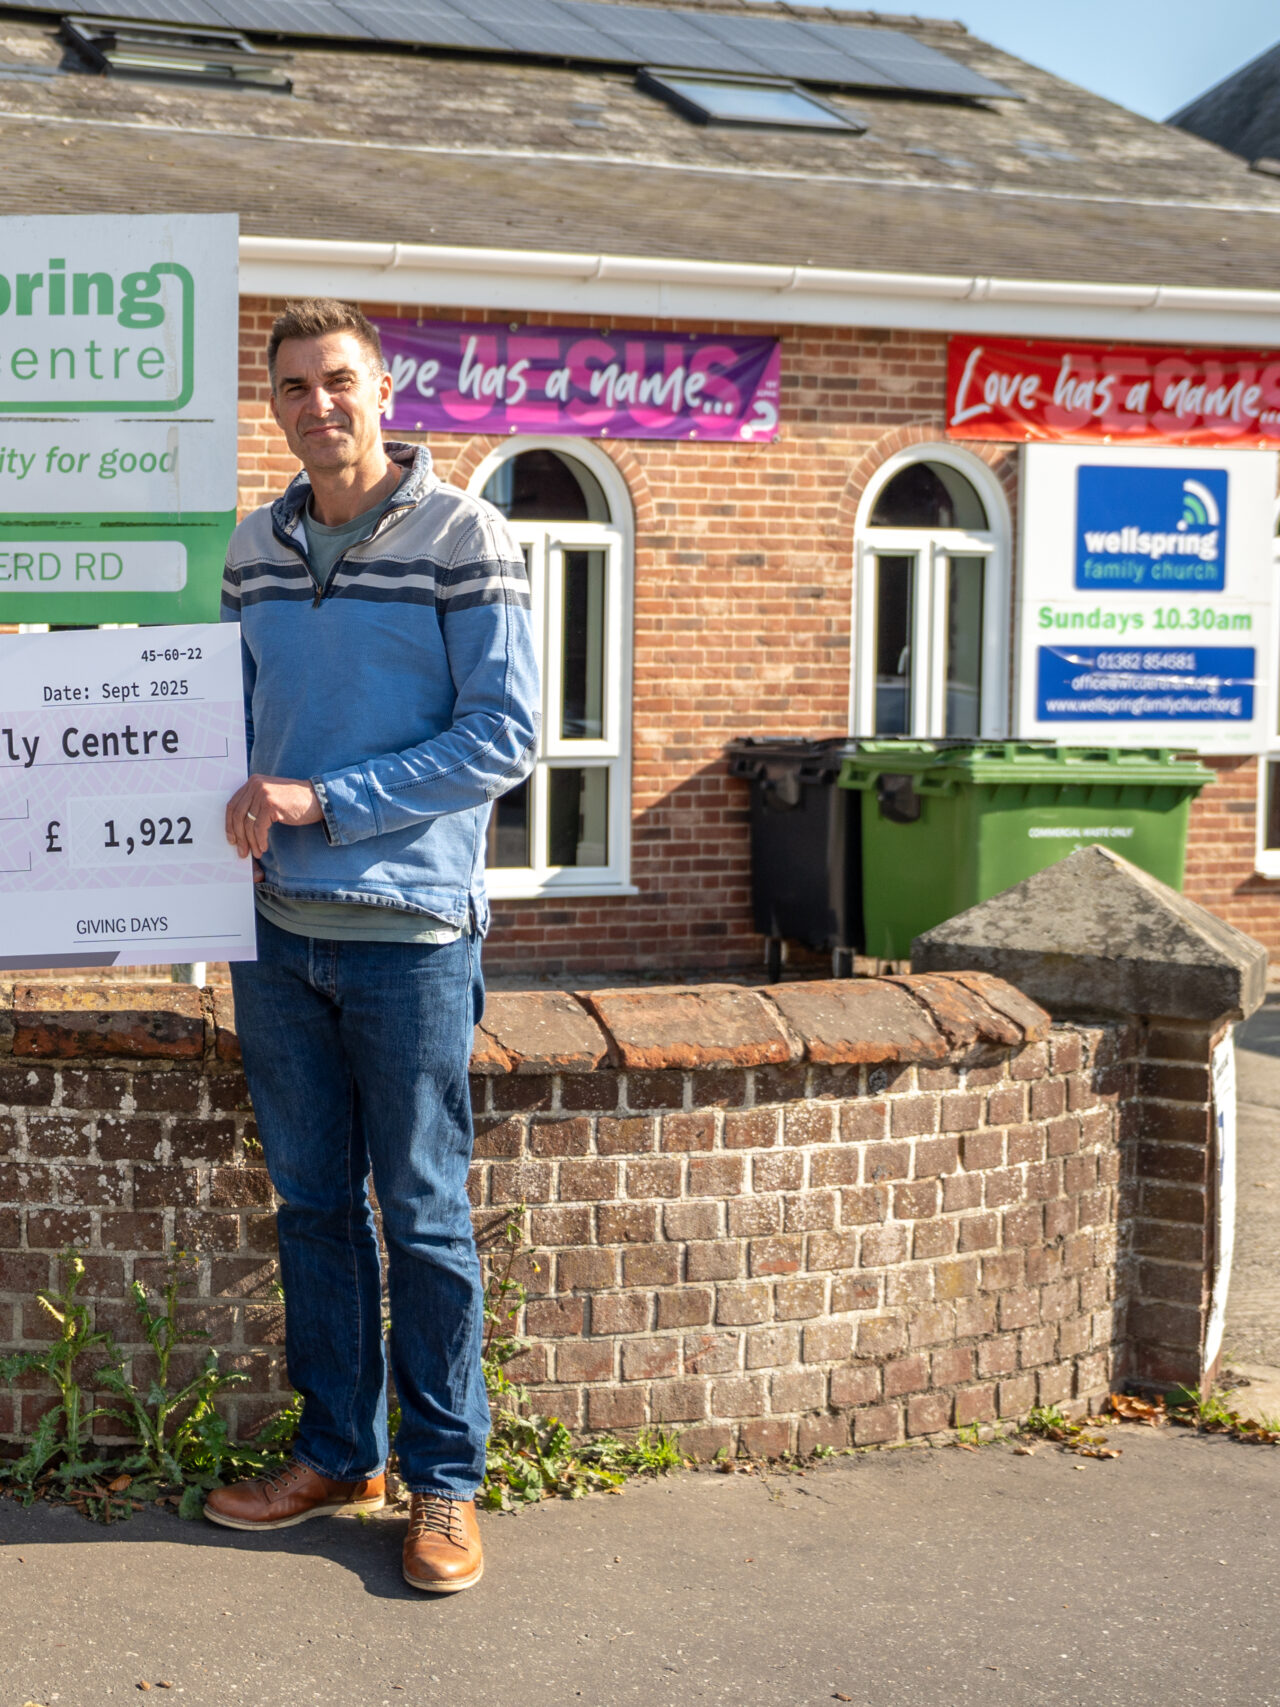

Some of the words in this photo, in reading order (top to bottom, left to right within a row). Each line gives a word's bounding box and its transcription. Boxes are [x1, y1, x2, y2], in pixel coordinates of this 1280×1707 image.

[458, 336, 530, 405] has
[545, 368, 570, 402] a
[951, 346, 1040, 426] Love
[1053, 353, 1115, 417] has
[1125, 381, 1151, 413] a
[45, 446, 90, 474] for
[98, 446, 179, 479] good
[1083, 520, 1219, 561] wellspring
[75, 552, 124, 581] RD
[1084, 558, 1145, 583] family
[1151, 561, 1218, 580] church
[1038, 606, 1144, 634] Sundays
[1152, 607, 1252, 630] 10.30am
[141, 648, 203, 662] 45-60-22
[43, 685, 89, 702] Date:
[102, 682, 140, 702] Sept
[150, 680, 189, 697] 2025
[62, 725, 179, 758] Centre
[45, 821, 62, 853] £
[104, 816, 193, 855] 1,922
[76, 919, 126, 934] GIVING
[131, 916, 168, 932] DAYS
